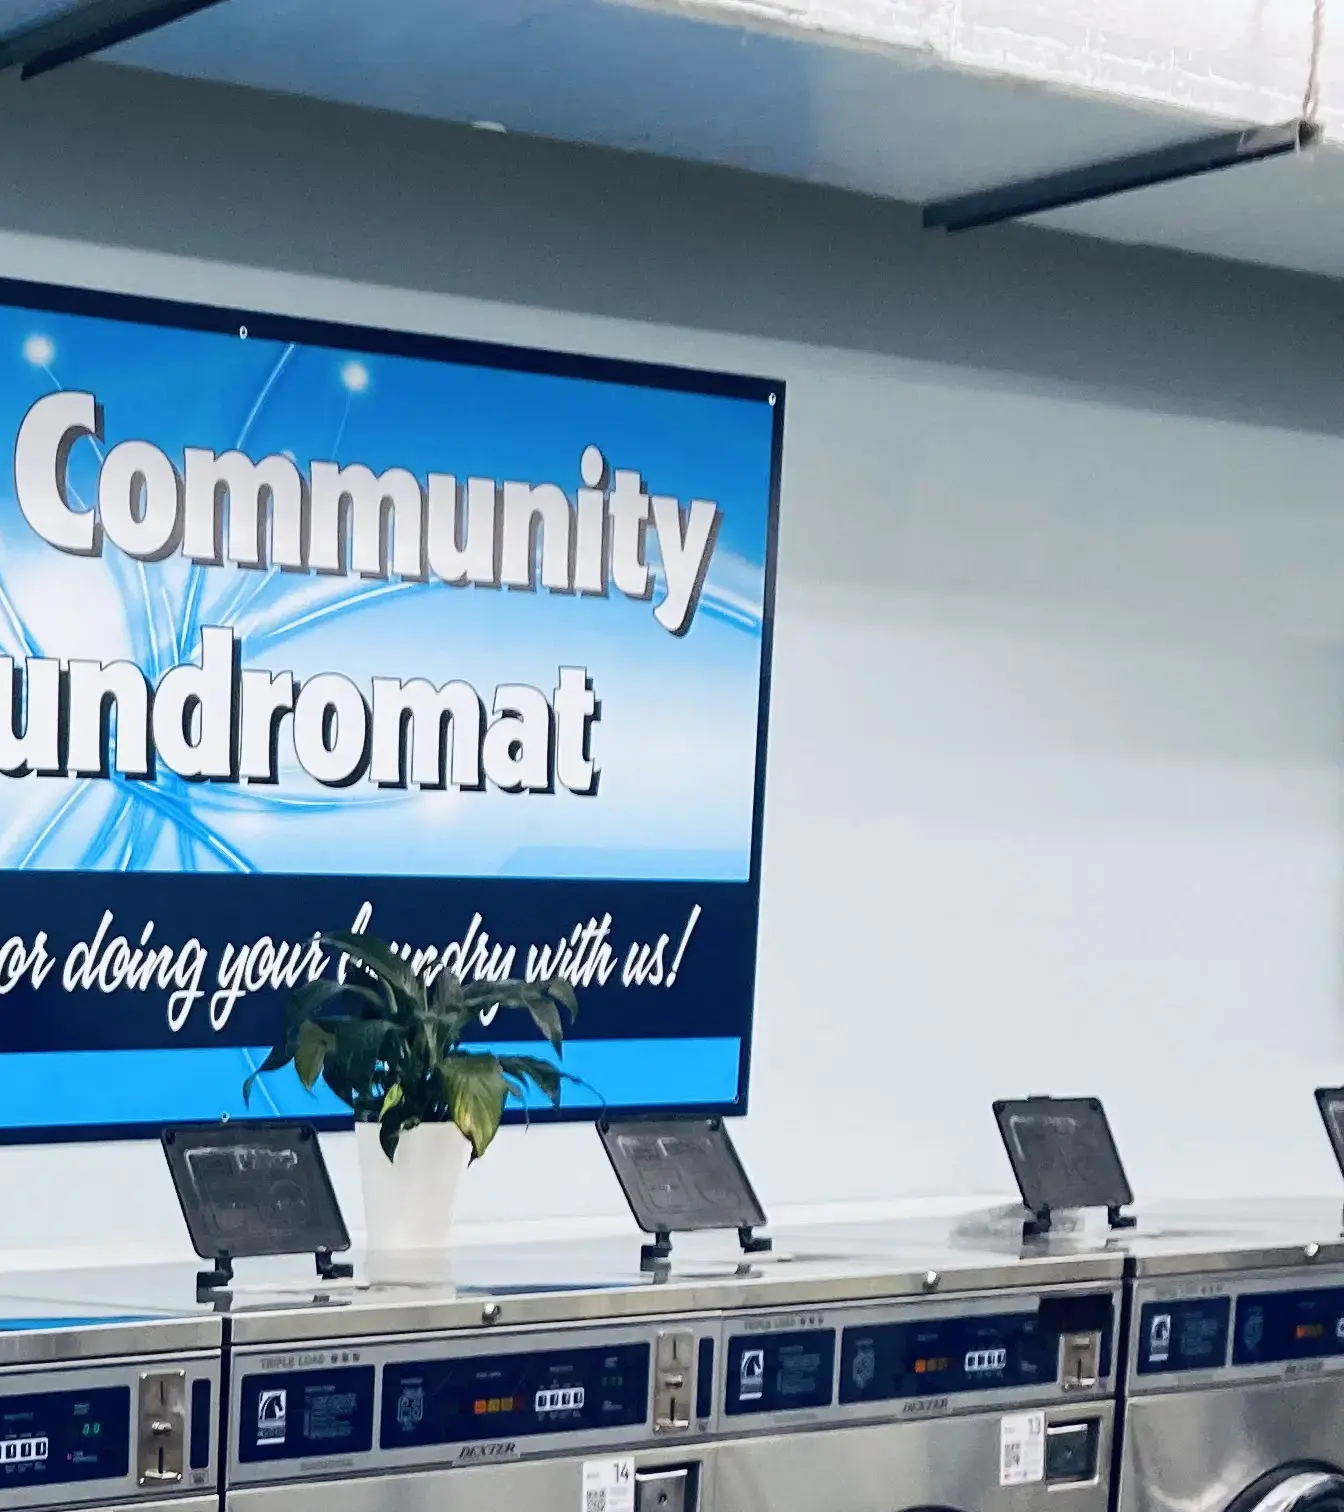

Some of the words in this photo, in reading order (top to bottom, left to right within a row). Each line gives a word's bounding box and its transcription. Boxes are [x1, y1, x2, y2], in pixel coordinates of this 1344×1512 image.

[14, 389, 723, 638] Community
[62, 909, 207, 1032] doing
[210, 930, 331, 1031] your
[527, 912, 618, 988] with
[622, 904, 702, 988] us!
[460, 1442, 516, 1458] DEXTER
[613, 1462, 630, 1484] 14
